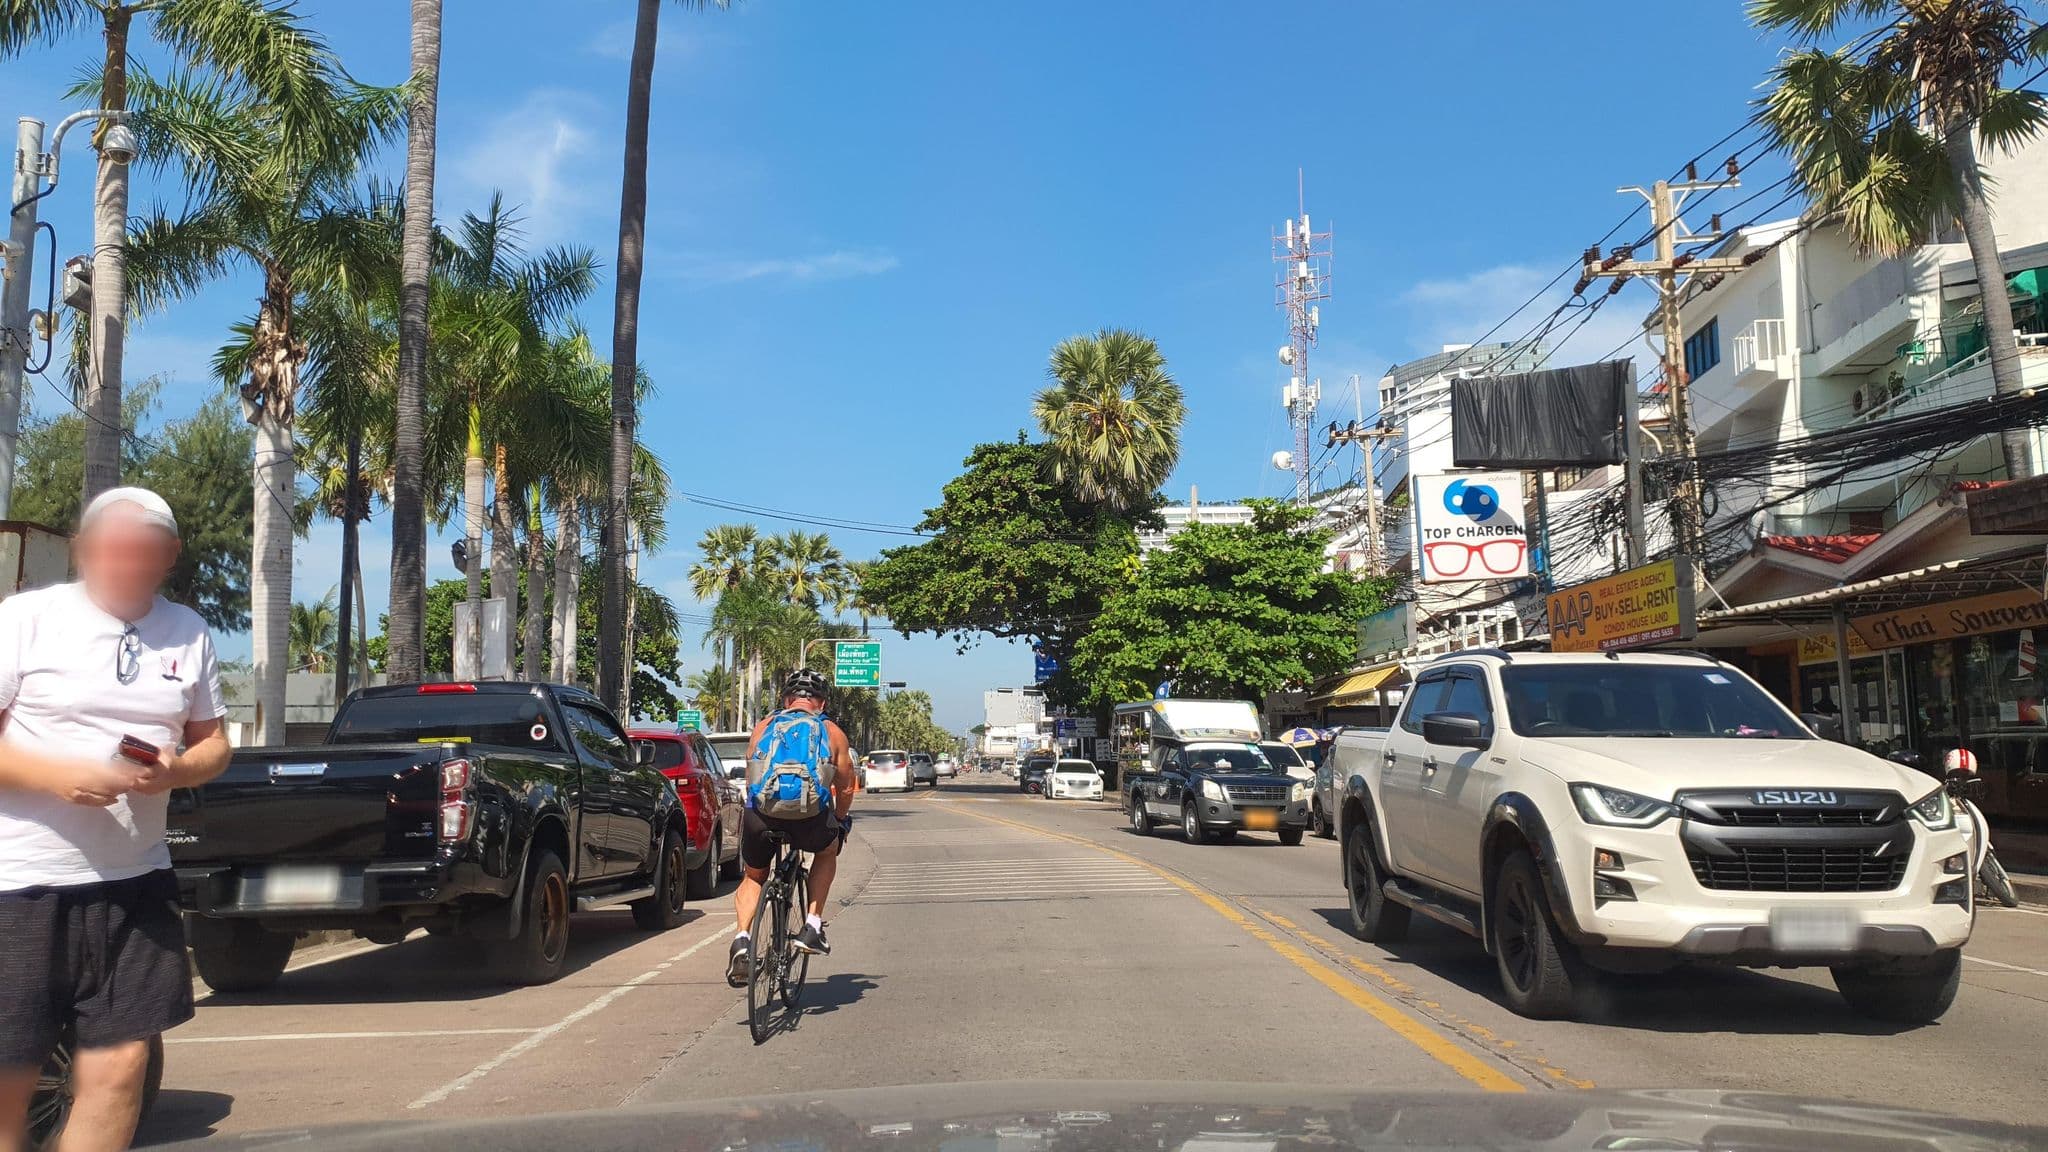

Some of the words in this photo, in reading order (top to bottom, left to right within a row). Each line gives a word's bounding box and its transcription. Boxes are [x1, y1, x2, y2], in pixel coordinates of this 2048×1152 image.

[1424, 528, 1451, 539] TOP
[1456, 525, 1524, 538] CHAROEN
[1600, 588, 1615, 598] REAL
[1616, 580, 1639, 594] ESTATE
[1640, 571, 1666, 586] AGENCY
[1552, 590, 1592, 641] AAP
[1604, 622, 1626, 634] CONDO
[1626, 617, 1650, 630] HOUSE
[1651, 612, 1668, 624] LAND
[1872, 614, 1936, 643] Thai
[1756, 791, 1838, 804] ISUZU
